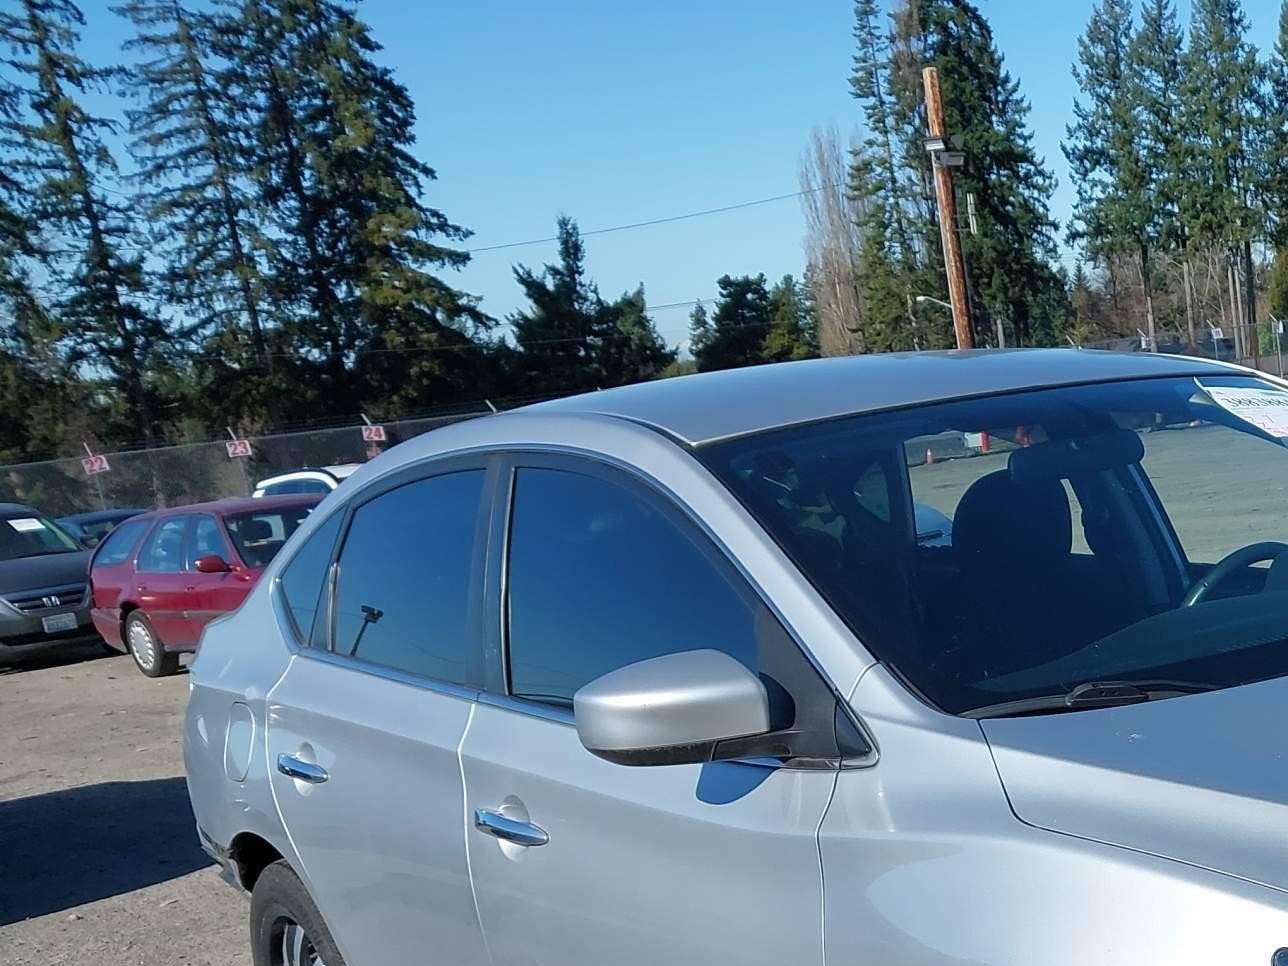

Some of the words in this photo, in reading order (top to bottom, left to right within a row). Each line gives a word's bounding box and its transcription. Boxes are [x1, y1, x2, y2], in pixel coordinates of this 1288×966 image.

[364, 427, 382, 440] 24
[229, 441, 249, 456] 23
[84, 456, 107, 473] 22
